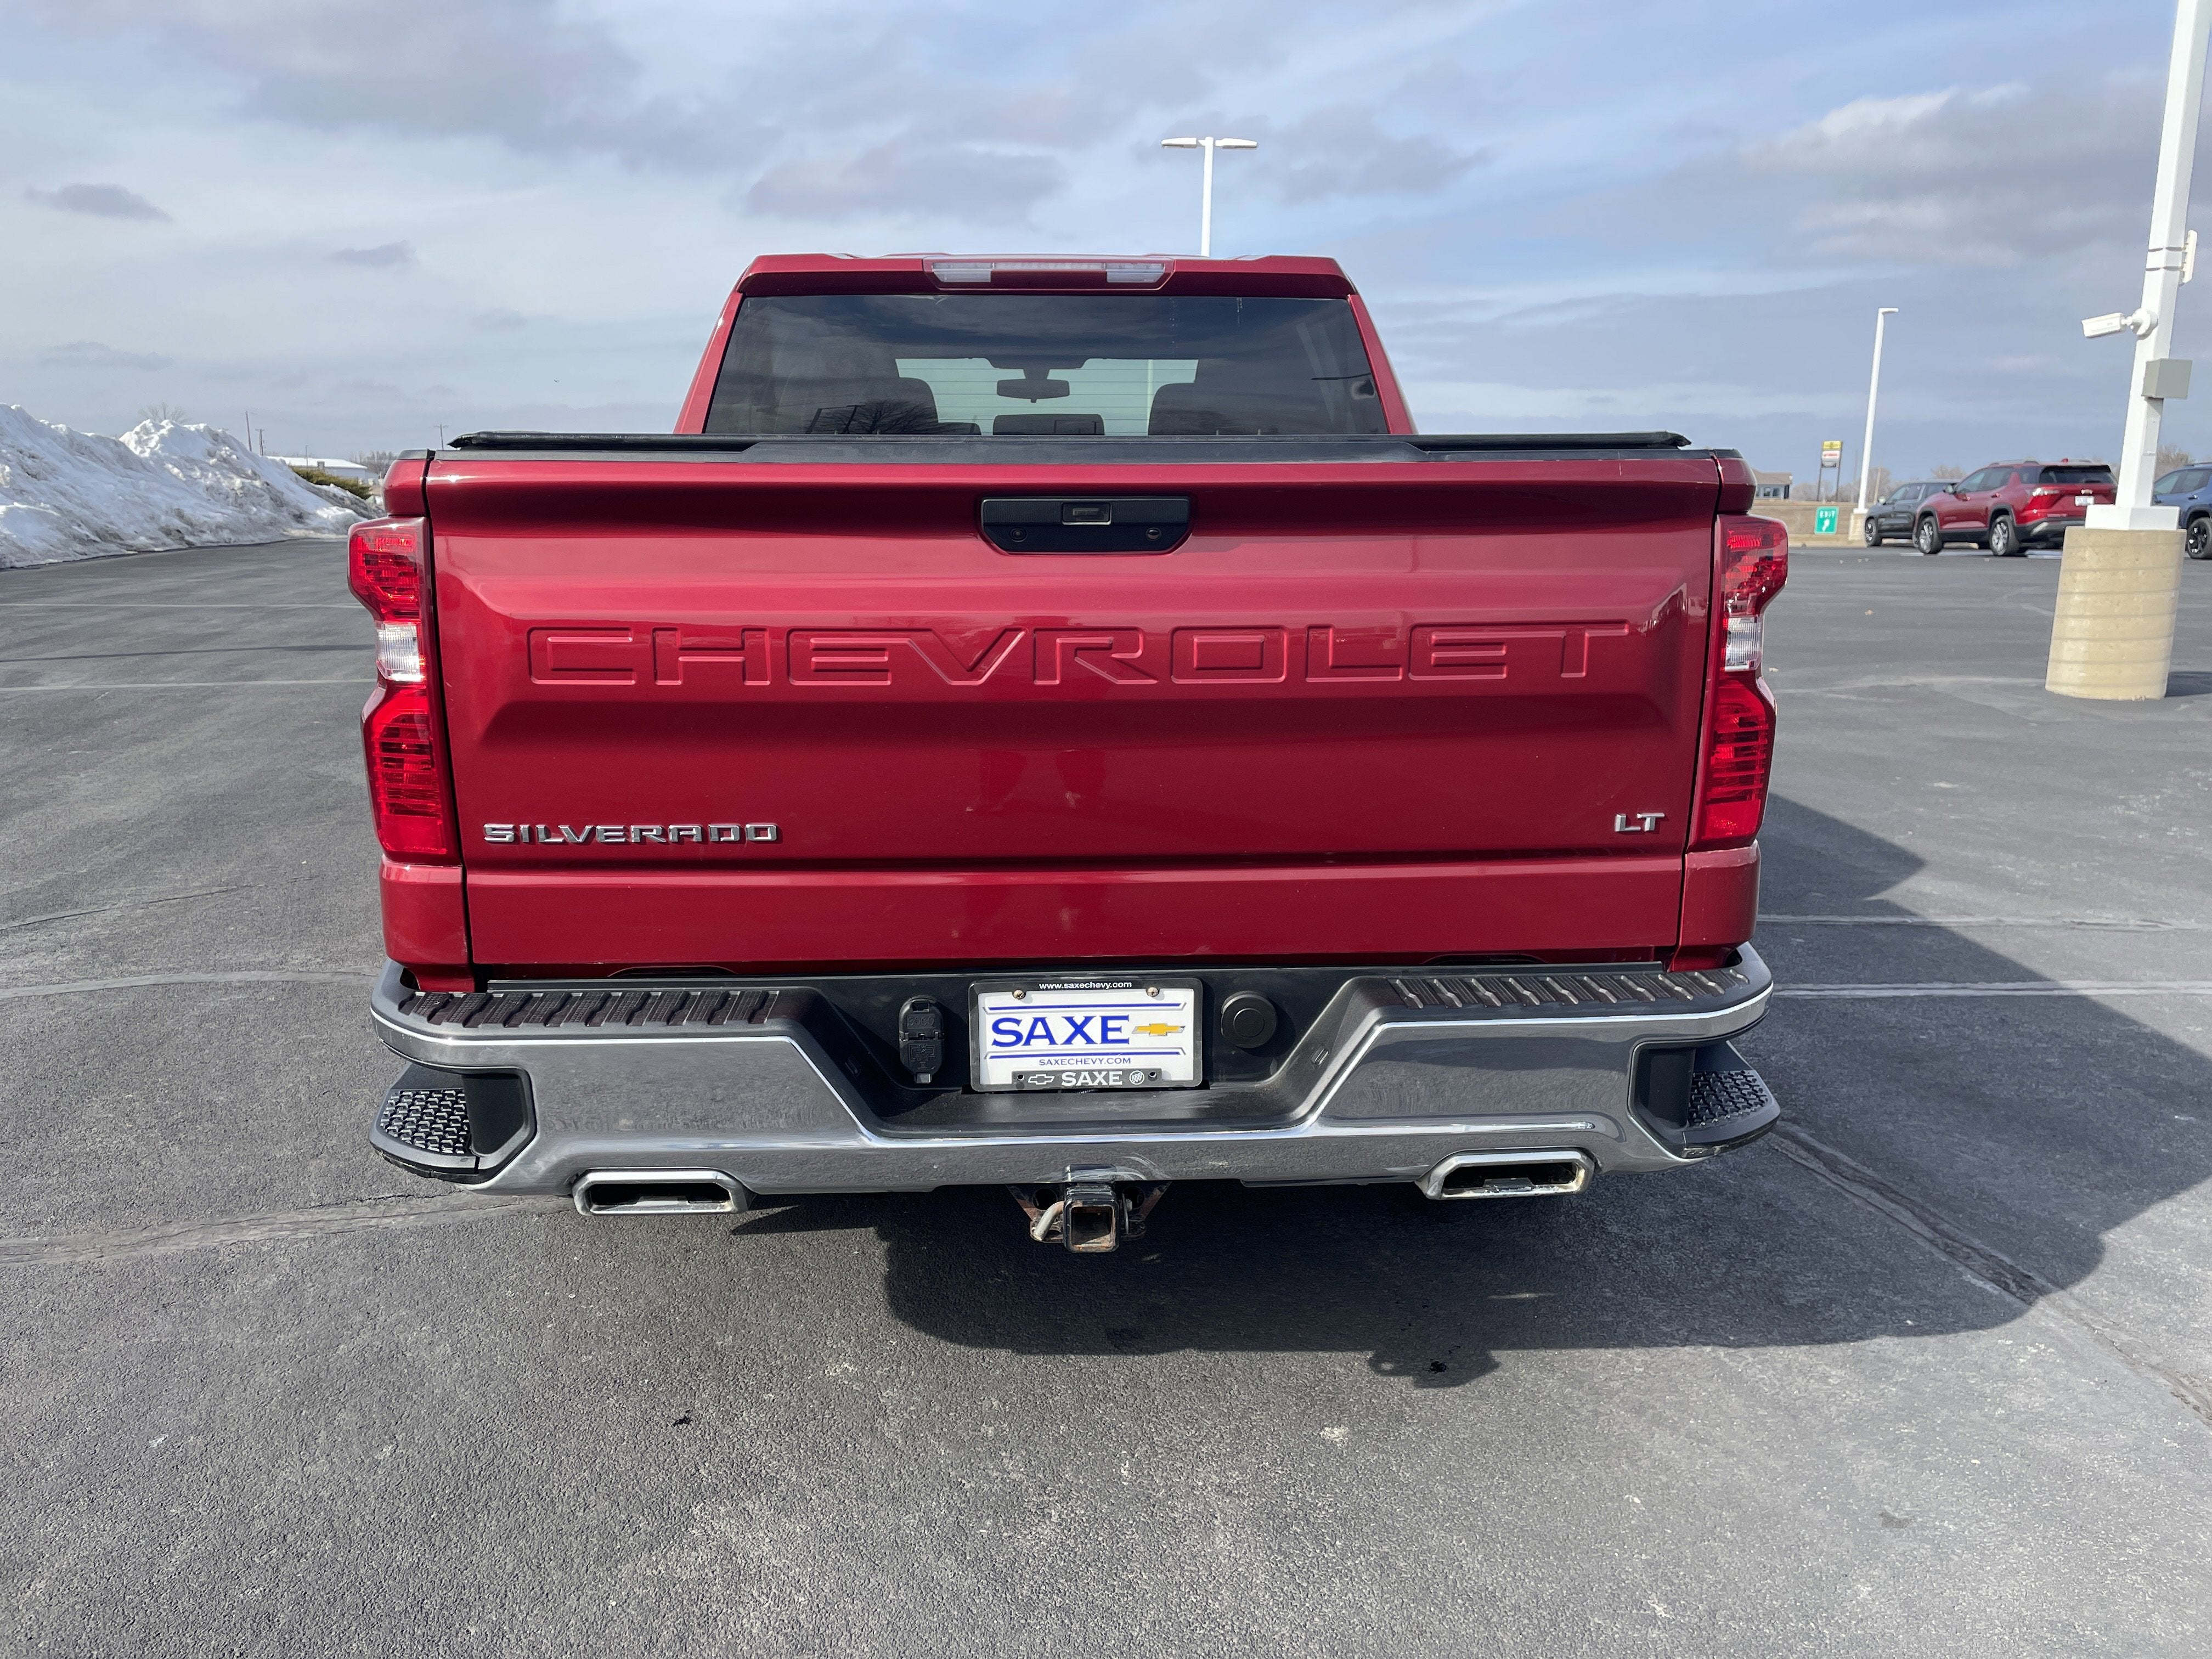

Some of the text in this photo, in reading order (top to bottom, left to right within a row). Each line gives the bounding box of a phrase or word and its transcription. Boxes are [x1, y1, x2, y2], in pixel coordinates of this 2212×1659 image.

[526, 619, 1629, 687] CHEVROLET
[1615, 812, 1666, 832] LT
[483, 823, 777, 843] SILVERADO
[1039, 981, 1132, 990] www.saxechevy.com
[991, 1014, 1130, 1048] SAXE
[1039, 1057, 1132, 1066] SAXECHEVY.COM
[1061, 1070, 1123, 1087] SAXE
